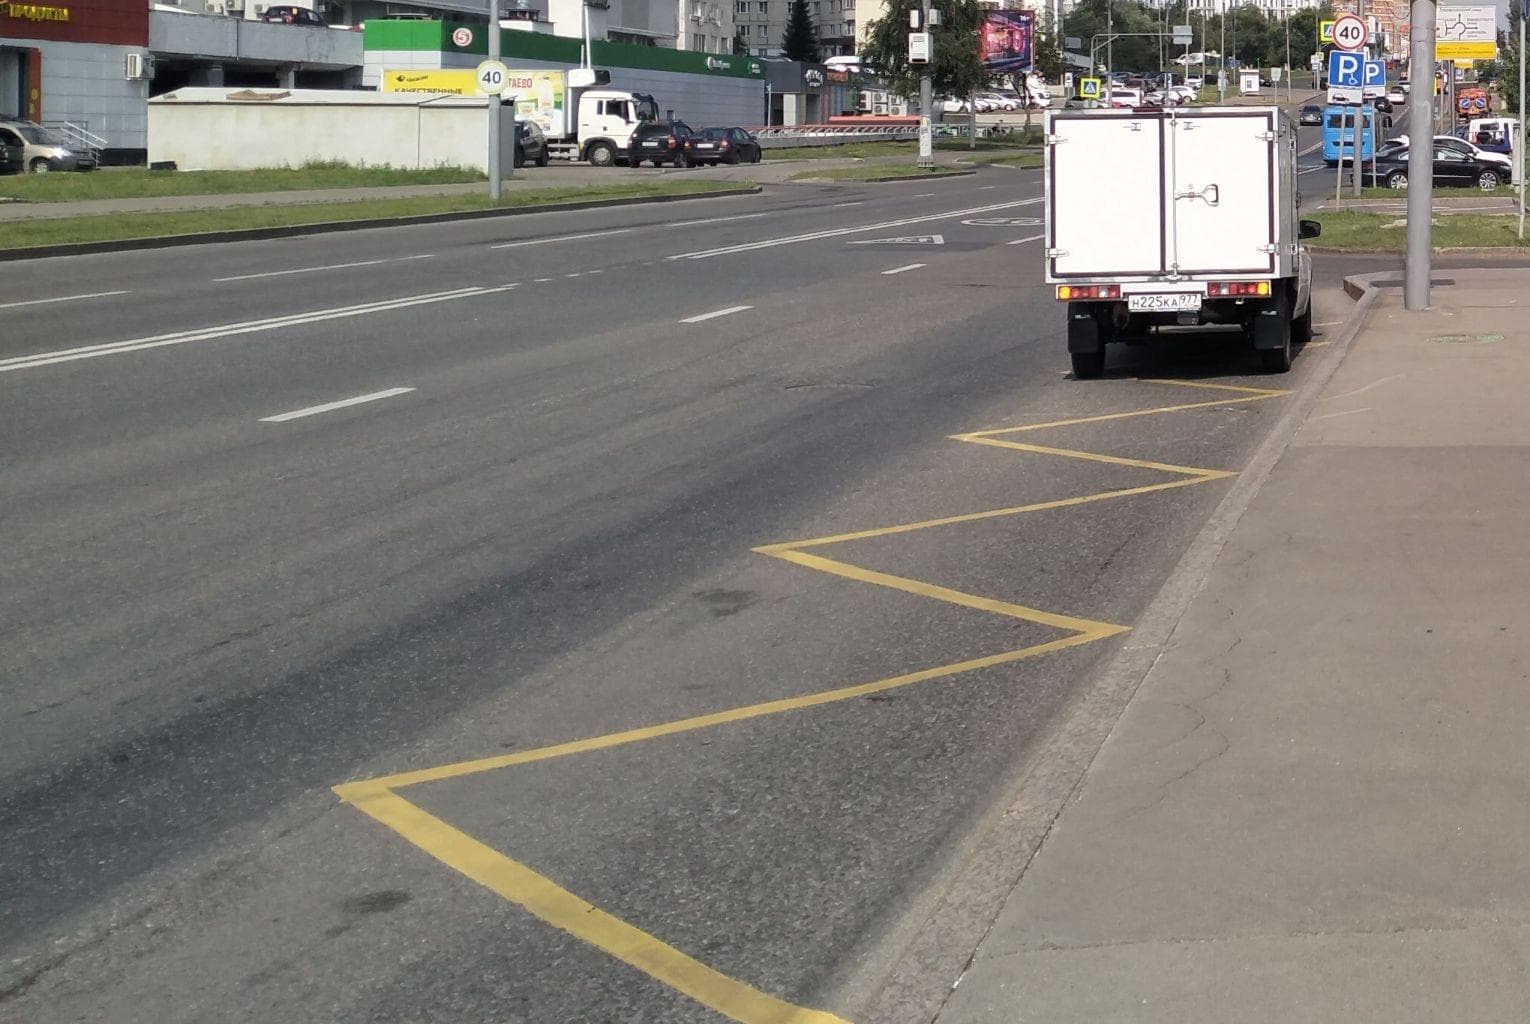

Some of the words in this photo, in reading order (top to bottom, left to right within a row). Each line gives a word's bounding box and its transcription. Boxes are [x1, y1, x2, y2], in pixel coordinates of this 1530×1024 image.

[1339, 26, 1360, 40] 40
[482, 71, 502, 84] 40
[1365, 63, 1379, 84] P
[1132, 296, 1178, 308] Н225КА
[1180, 295, 1198, 304] 977
